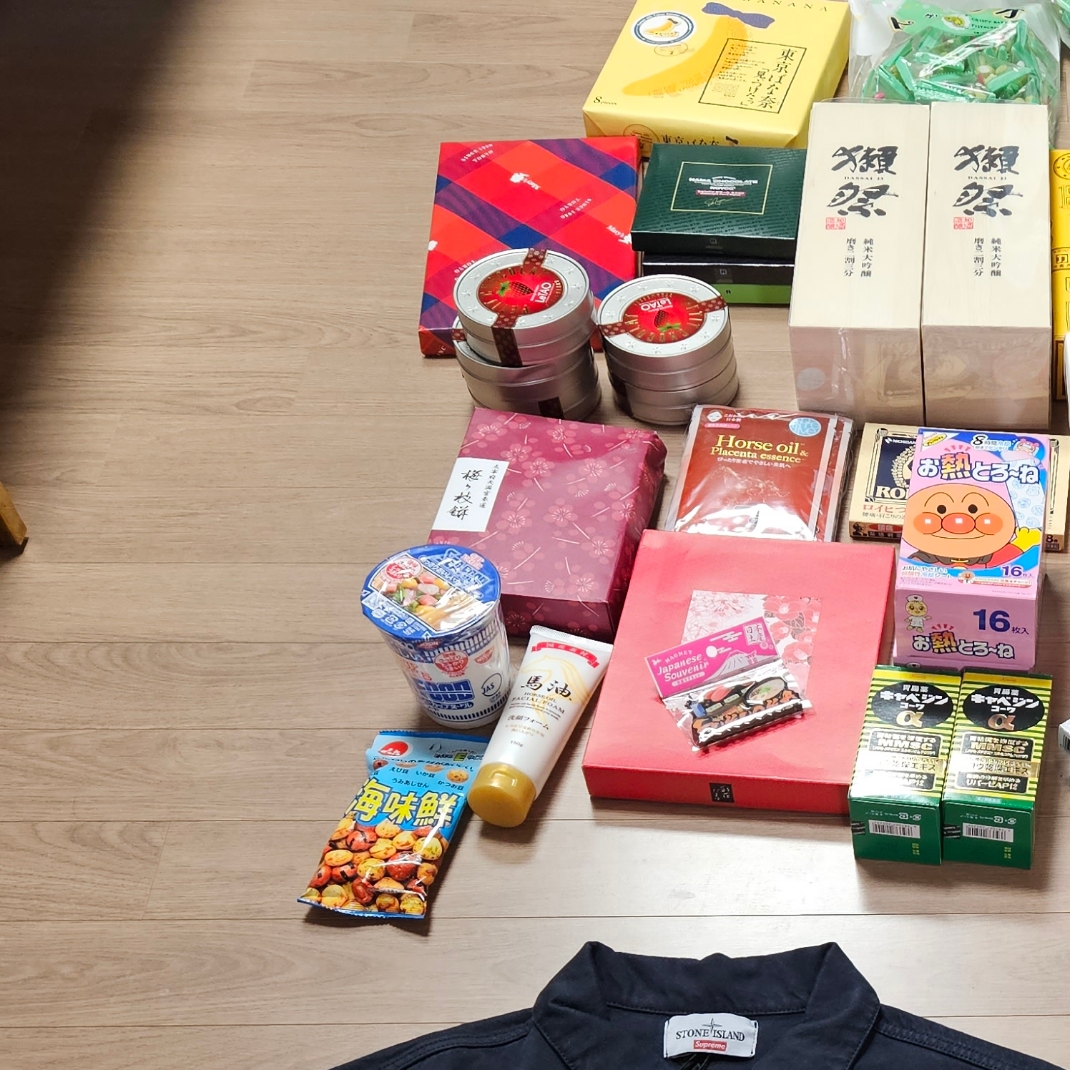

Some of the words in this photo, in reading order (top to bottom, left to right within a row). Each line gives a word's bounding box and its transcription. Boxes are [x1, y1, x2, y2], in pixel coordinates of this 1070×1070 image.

[757, 48, 797, 109] 東京ばな奈
[860, 238, 874, 278] 純米大吟醸
[990, 237, 1002, 277] 純米大吟醸
[535, 281, 552, 304] LeTAO
[640, 297, 671, 311] LeTAO
[715, 434, 773, 451] Horse
[776, 441, 800, 455] oil
[710, 446, 757, 458] Placenta
[760, 453, 801, 463] essence
[657, 652, 703, 676] Japanese
[665, 649, 693, 664] MAGNET
[663, 661, 710, 682] Souvenir
[482, 682, 495, 694] JAS
[521, 675, 573, 701] 馬油
[512, 696, 540, 705] FACIAL
[541, 701, 566, 714] FOAM
[524, 691, 545, 699] HORSE
[545, 695, 557, 704] OIL
[880, 690, 949, 706] キャベジン
[970, 693, 1040, 709] キャベジン
[899, 702, 925, 711] コーワ
[990, 705, 1016, 714] コーワ
[878, 738, 934, 751] MMSC
[971, 742, 1026, 754] MMSC
[392, 777, 430, 789] うみあじせん
[437, 780, 465, 791] かつお豆
[676, 1028, 709, 1040] STONE
[712, 1029, 745, 1042] ISLAND
[694, 1040, 726, 1050] Supreme
